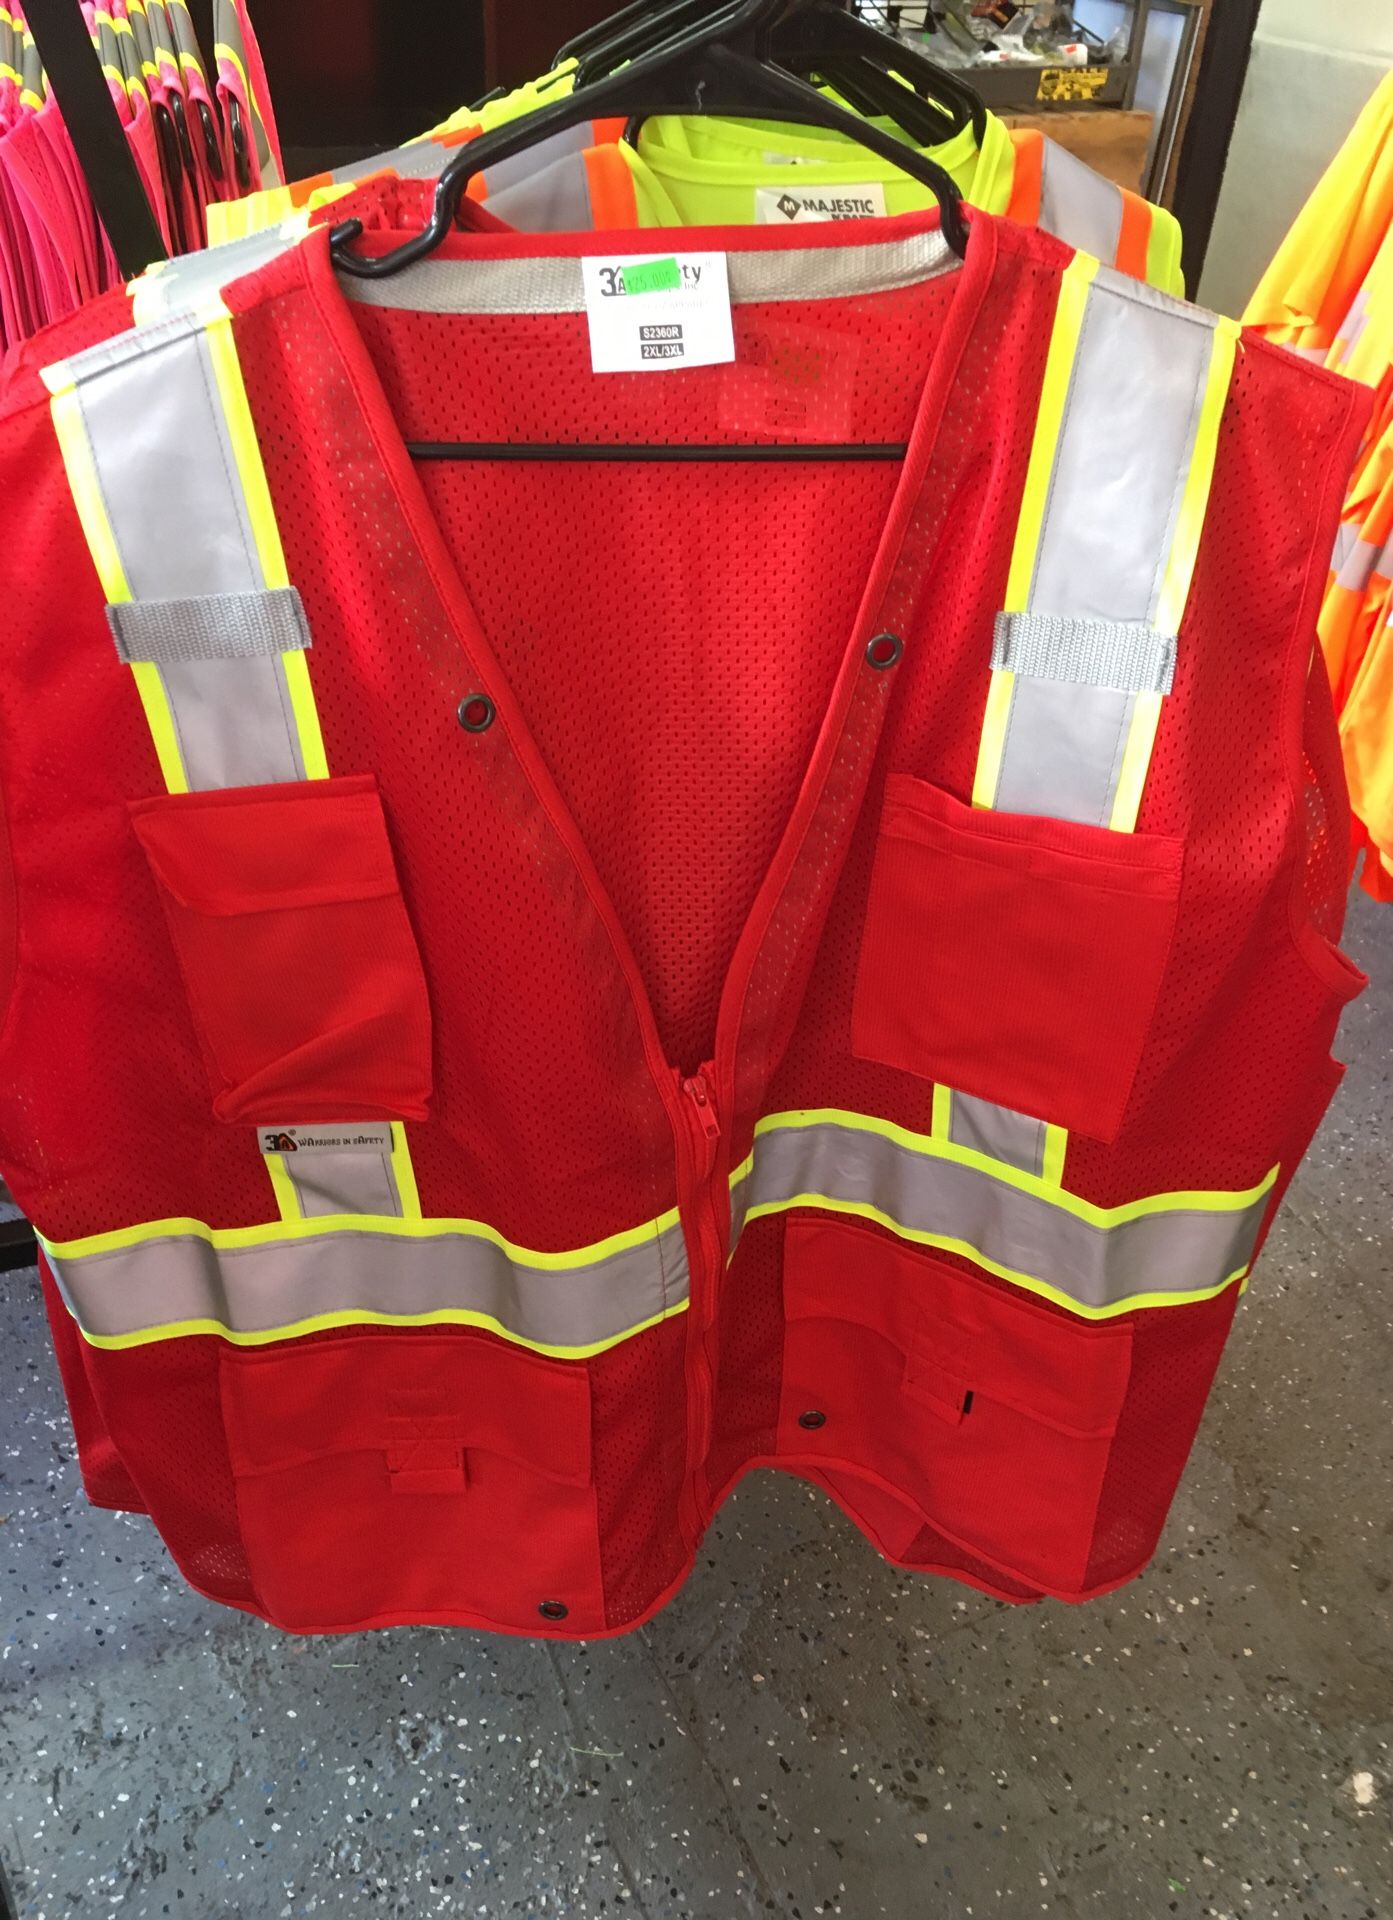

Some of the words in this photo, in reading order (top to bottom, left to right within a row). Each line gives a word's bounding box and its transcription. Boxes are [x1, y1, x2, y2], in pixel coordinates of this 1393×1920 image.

[802, 199, 875, 214] MAJESTIC
[643, 326, 680, 339] S2360R
[643, 344, 683, 357] 2XL/3XL
